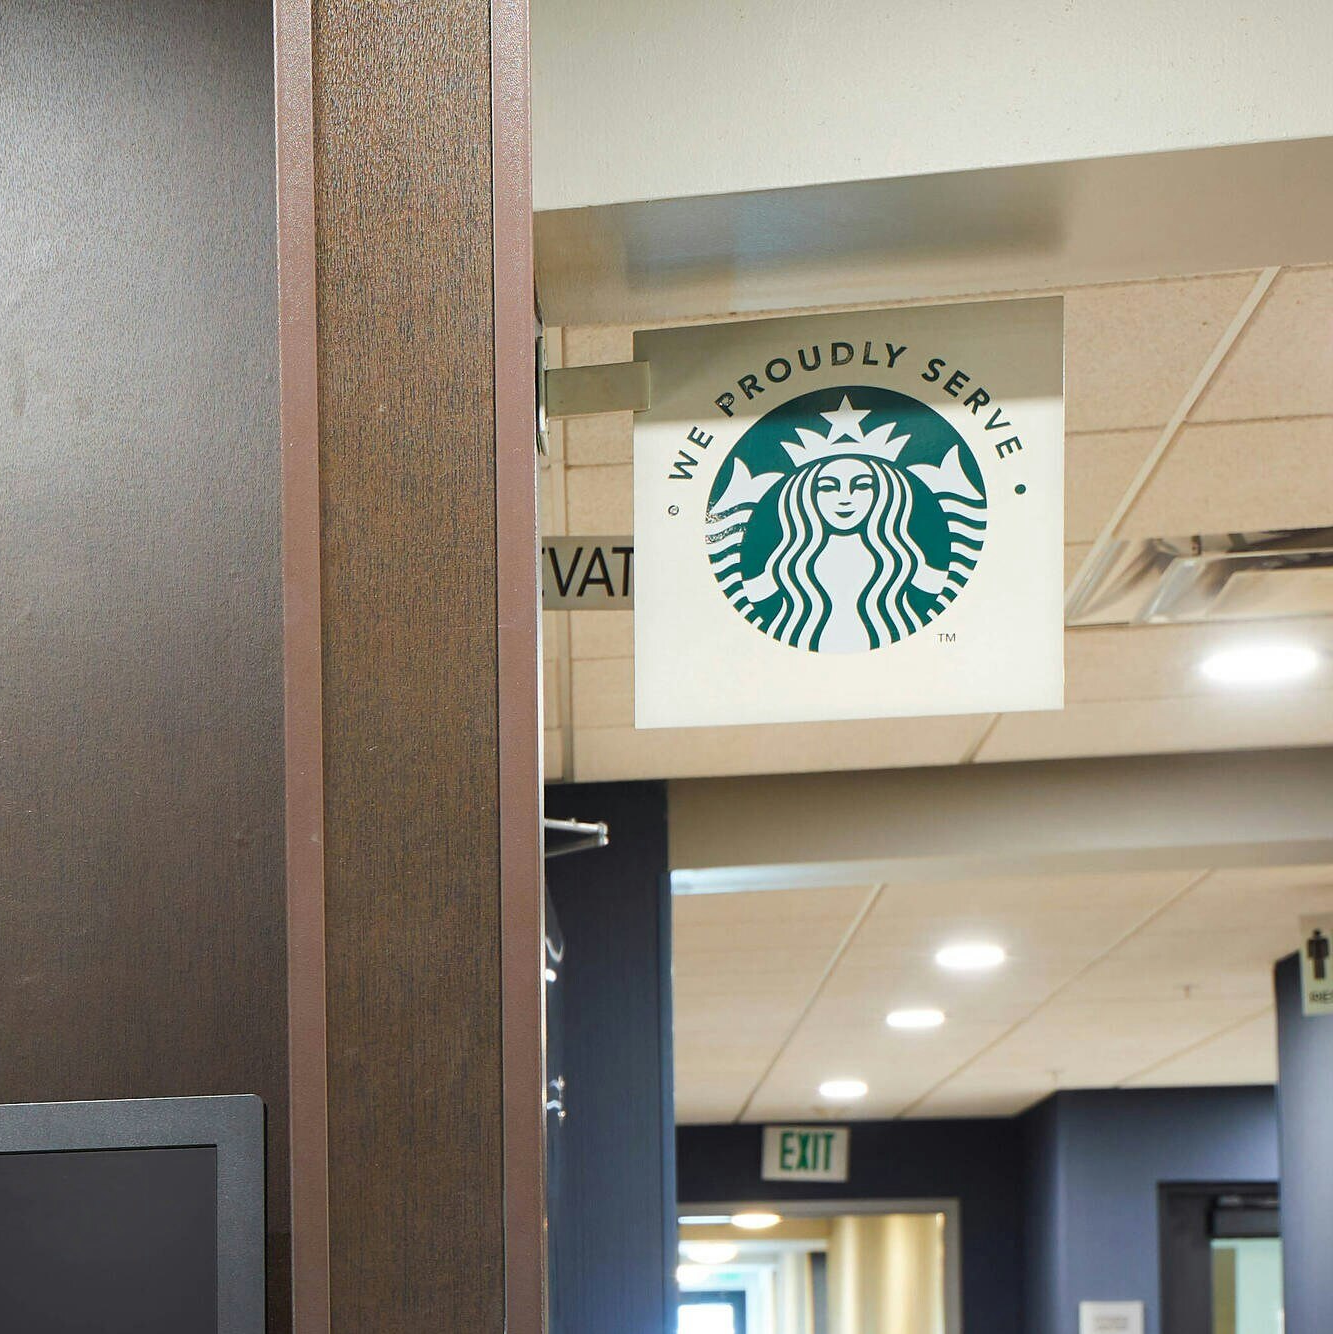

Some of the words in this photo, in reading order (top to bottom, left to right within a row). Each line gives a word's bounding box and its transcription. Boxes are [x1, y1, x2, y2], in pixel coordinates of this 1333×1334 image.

[669, 427, 714, 481] WE
[715, 341, 909, 417] PROUDLY
[921, 358, 1023, 460] SERVE
[542, 547, 634, 597] VAT
[780, 1132, 835, 1170] EXIT
